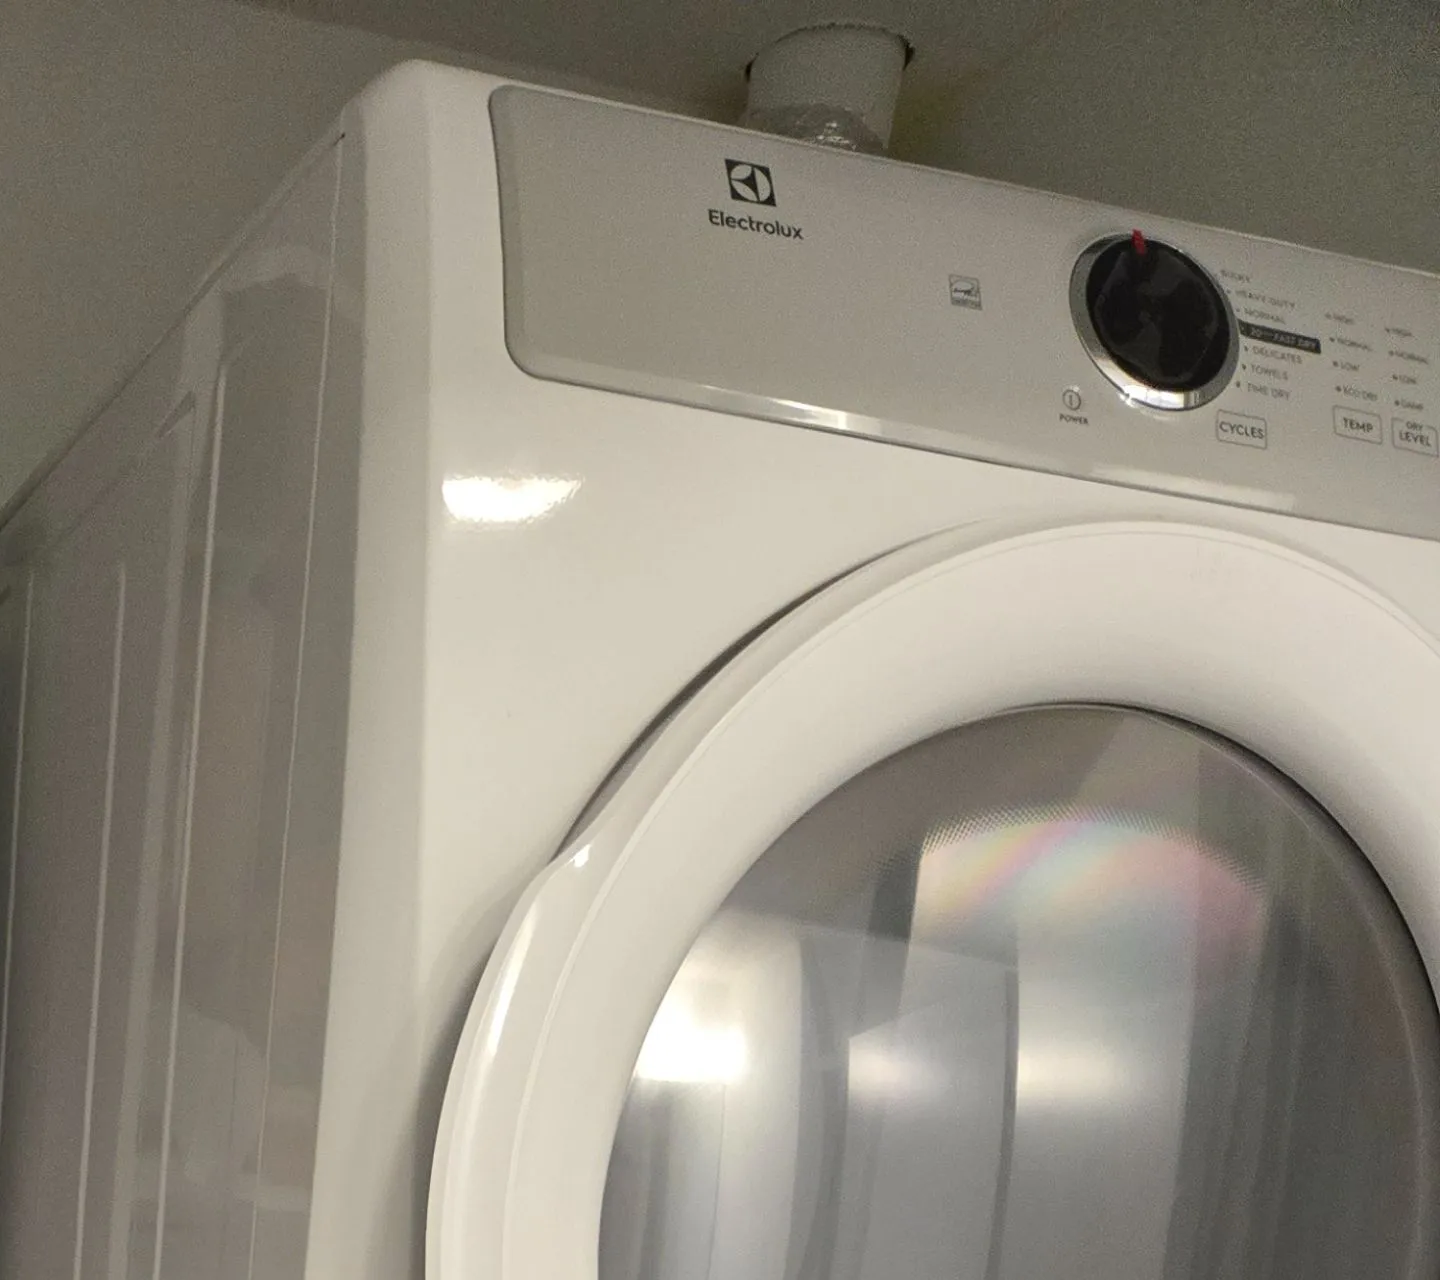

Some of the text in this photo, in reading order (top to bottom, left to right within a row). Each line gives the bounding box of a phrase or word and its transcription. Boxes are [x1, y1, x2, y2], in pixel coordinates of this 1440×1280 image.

[708, 208, 804, 240] Electrolux
[1059, 412, 1090, 426] POWER
[1342, 417, 1373, 433] TEMP
[1219, 420, 1265, 440] CYCLES
[1400, 430, 1432, 447] LEVEL
